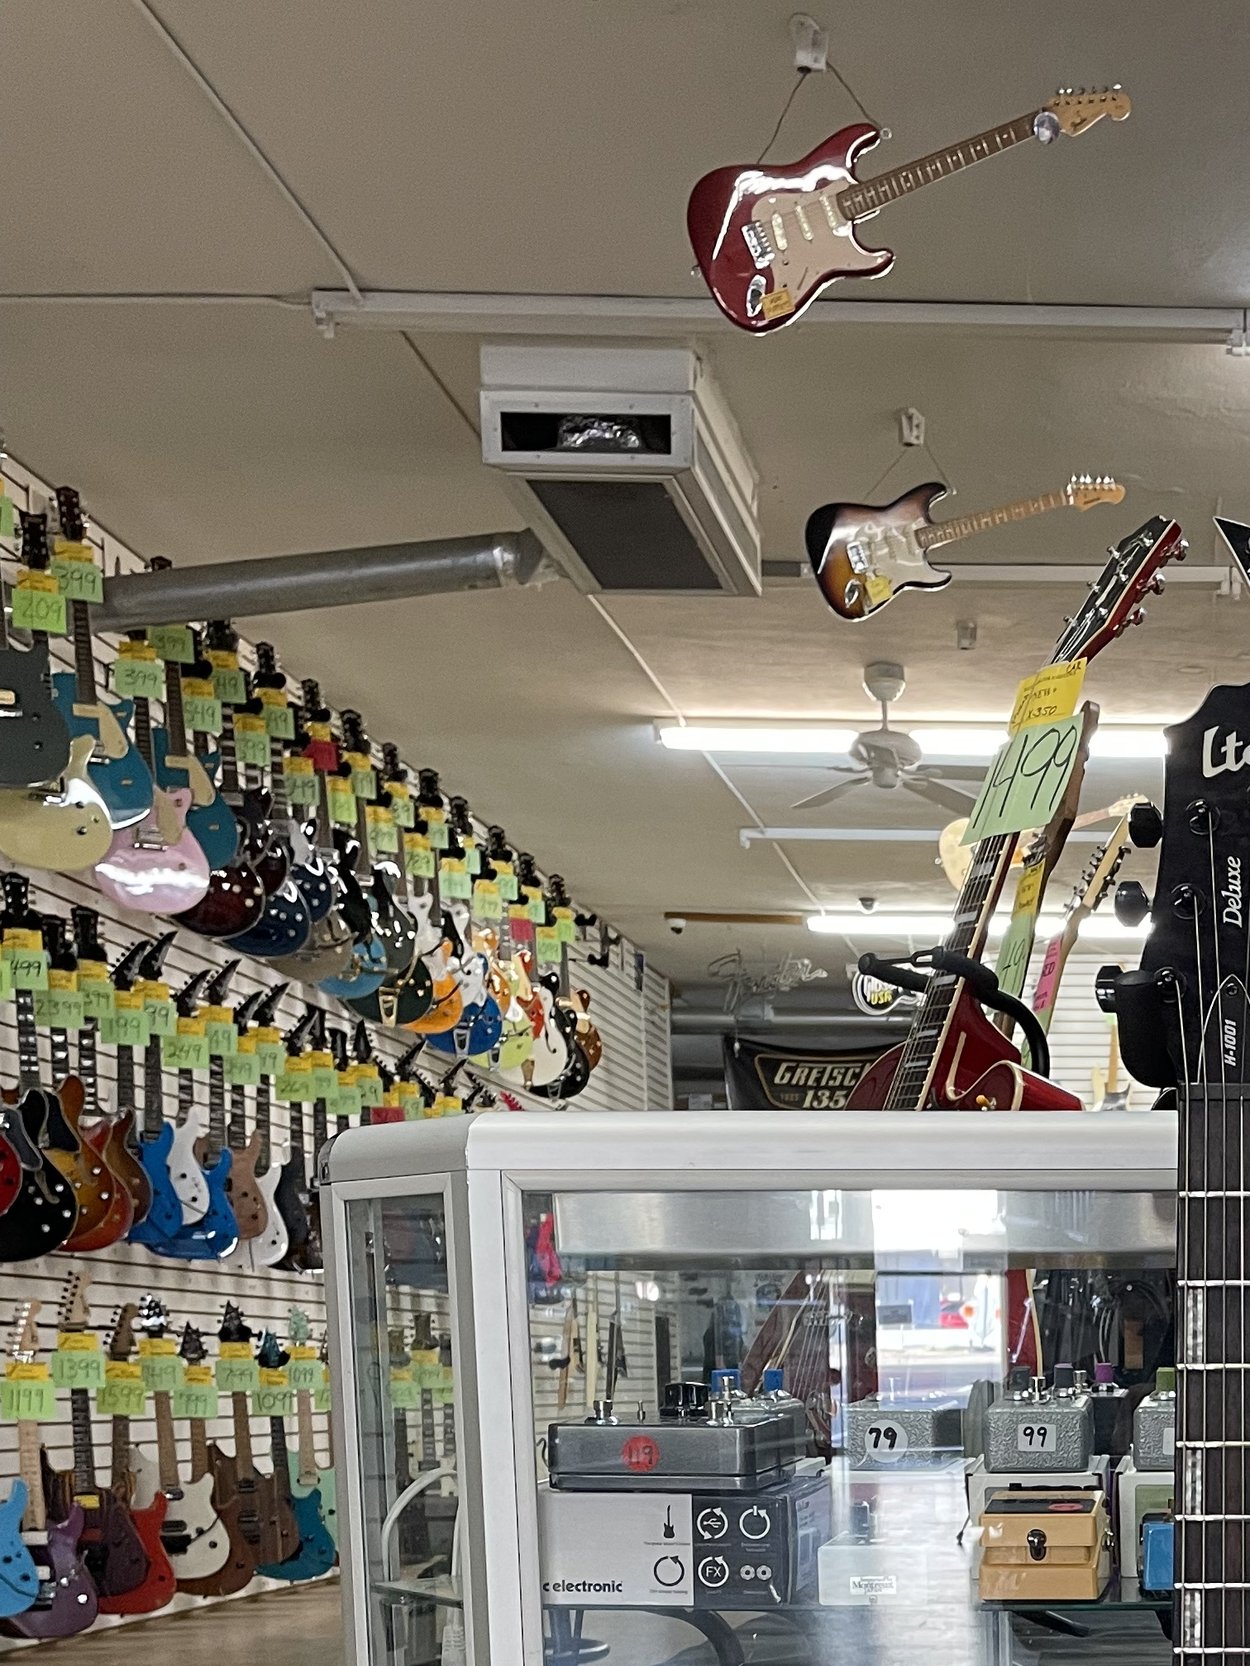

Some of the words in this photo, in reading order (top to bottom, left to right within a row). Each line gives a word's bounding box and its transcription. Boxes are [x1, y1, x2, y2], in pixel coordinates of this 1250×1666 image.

[972, 724, 1078, 830] 1499
[1220, 855, 1242, 929] Deluxe
[870, 990, 893, 1006] USA
[1224, 1018, 1237, 1067] H-1001
[774, 1062, 872, 1087] GRETSC
[802, 1089, 849, 1109] 135
[867, 1426, 898, 1450] 79
[1023, 1426, 1048, 1448] 99
[705, 1566, 722, 1578] FX
[552, 1580, 623, 1594] electronic
